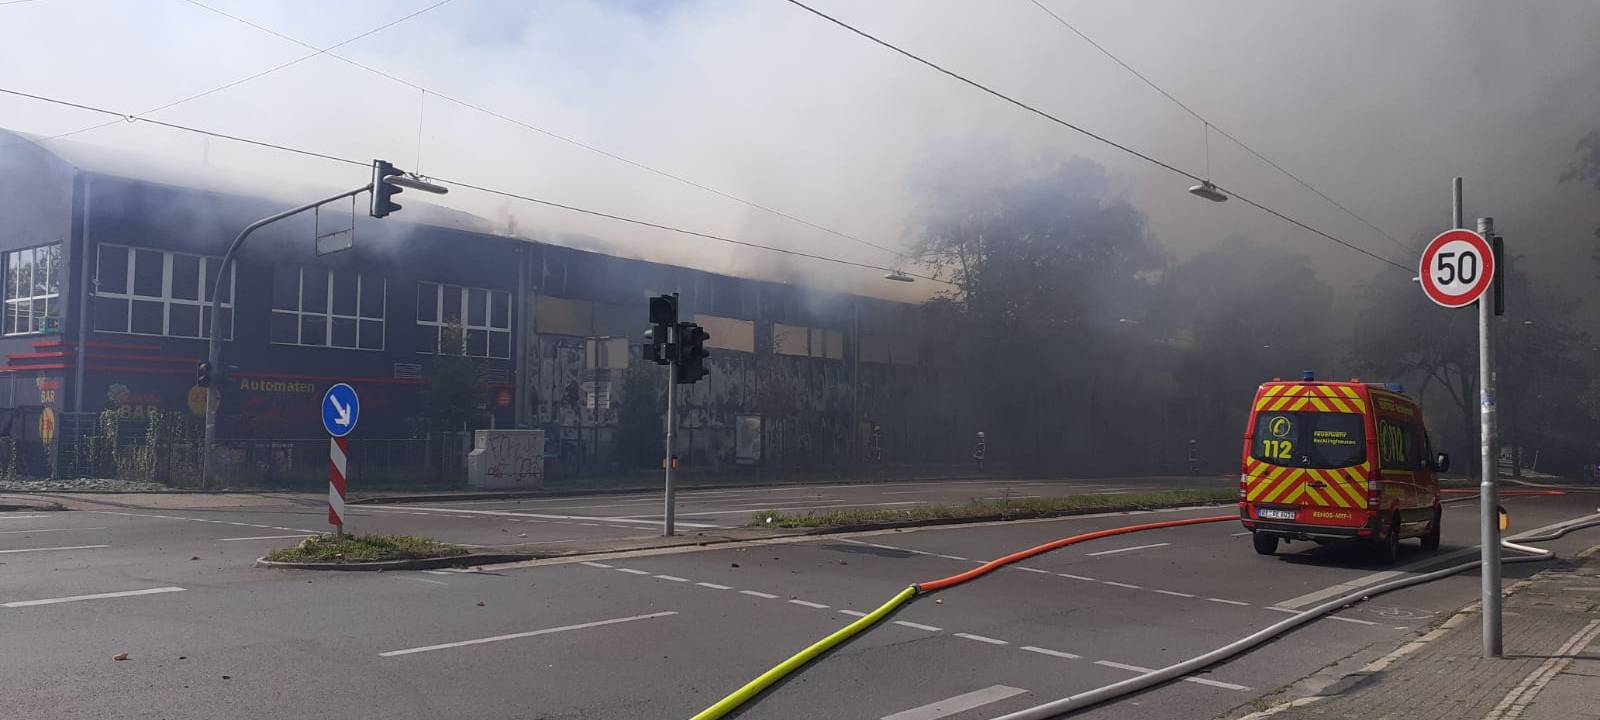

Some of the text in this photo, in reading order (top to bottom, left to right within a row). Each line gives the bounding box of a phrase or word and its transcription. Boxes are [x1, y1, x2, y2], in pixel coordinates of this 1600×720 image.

[1437, 250, 1477, 286] 50
[240, 378, 315, 393] Automaten
[40, 391, 55, 403] BAR
[120, 404, 159, 419] BAR
[1263, 439, 1292, 459] 112
